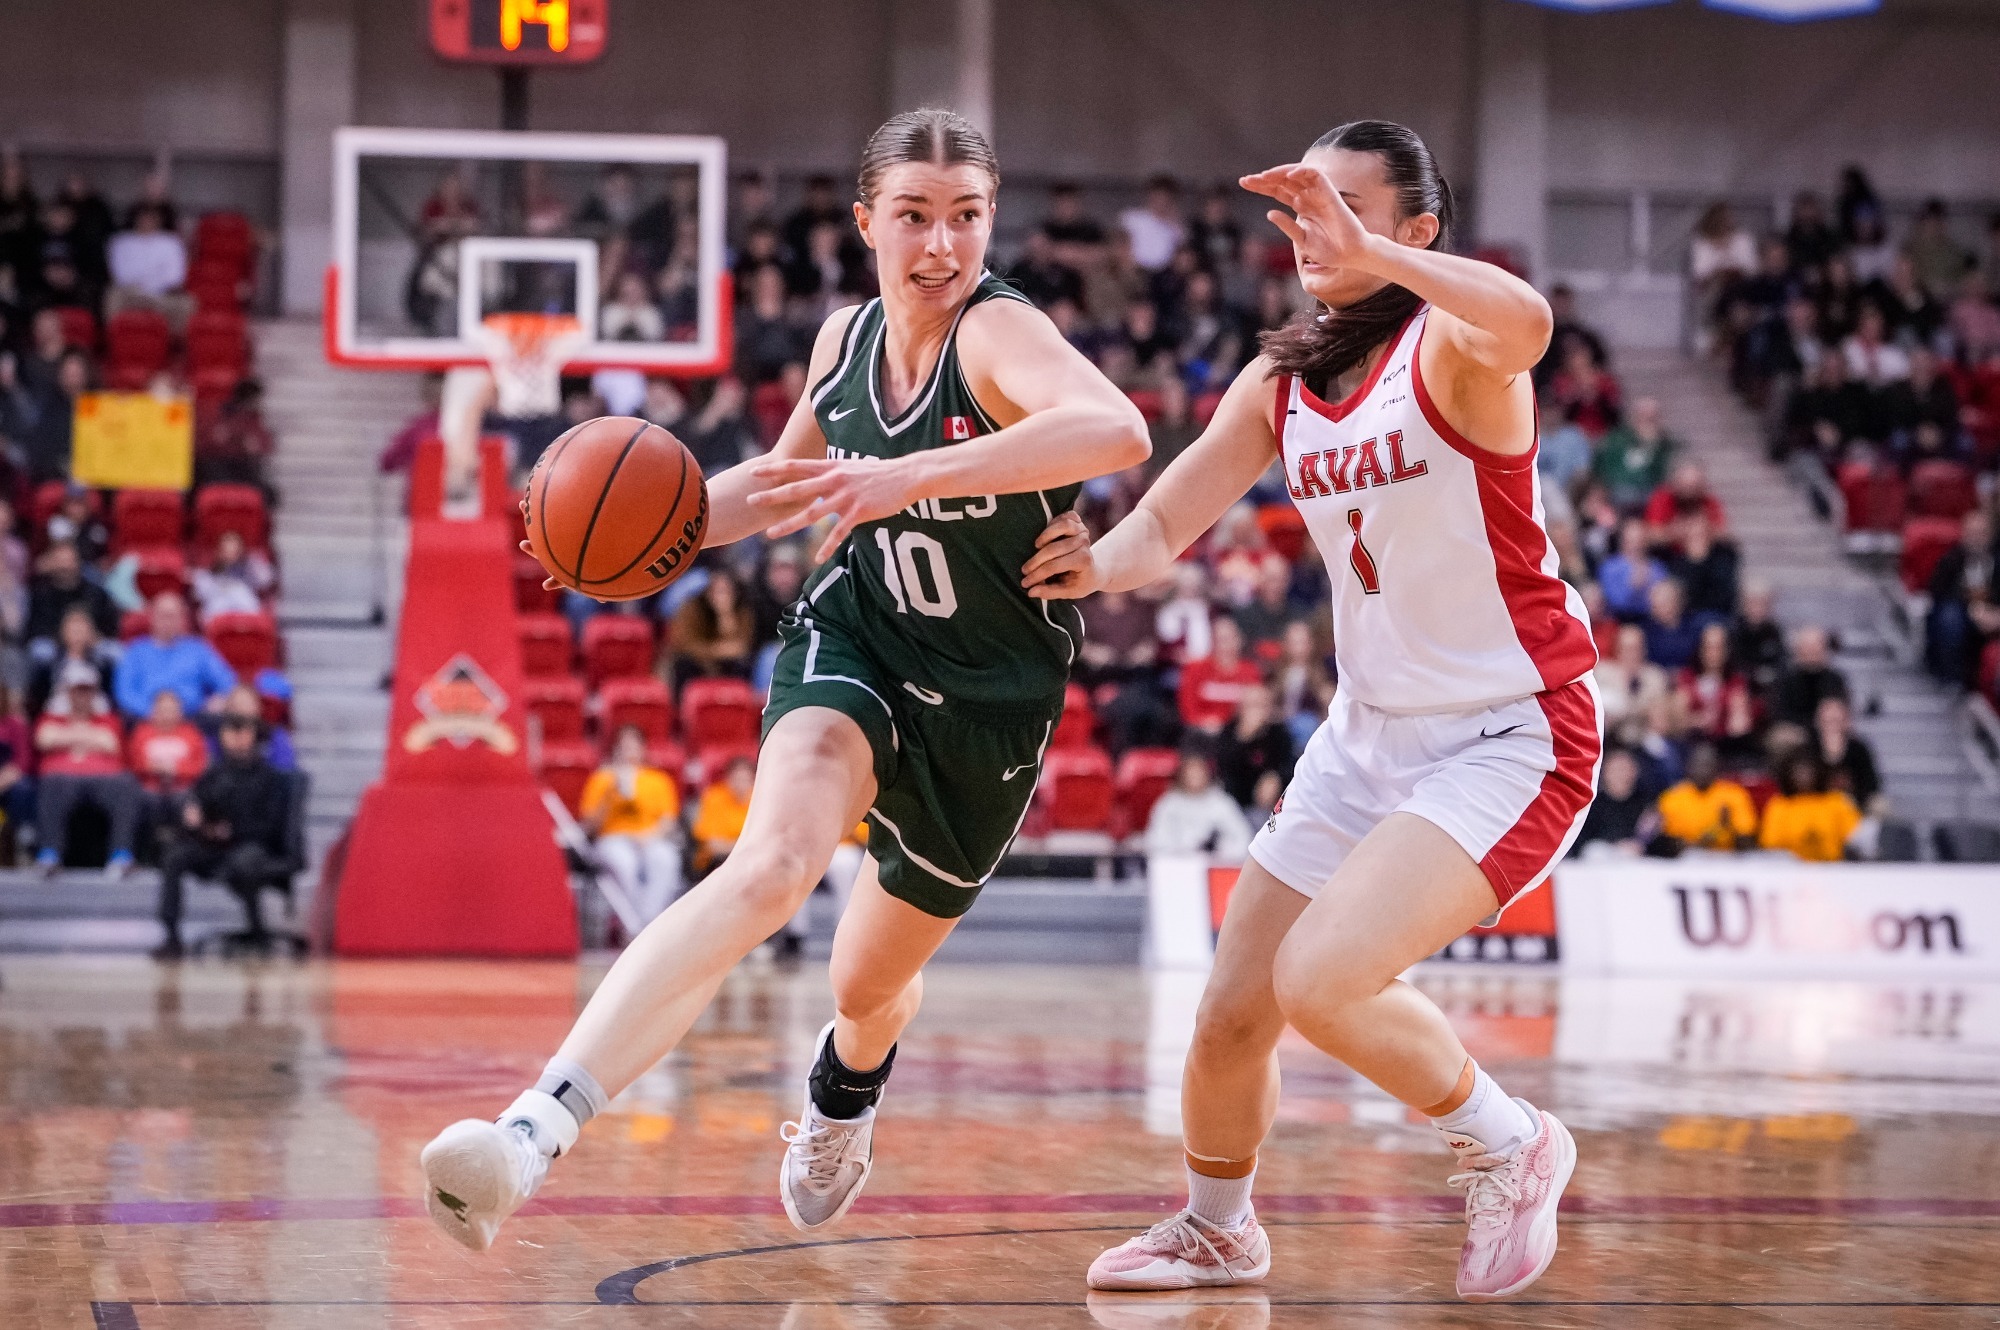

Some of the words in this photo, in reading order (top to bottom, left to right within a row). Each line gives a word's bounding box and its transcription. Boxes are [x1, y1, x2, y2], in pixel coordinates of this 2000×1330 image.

[1389, 394, 1406, 405] TELUS
[874, 527, 958, 619] 10
[1347, 508, 1381, 595] 1
